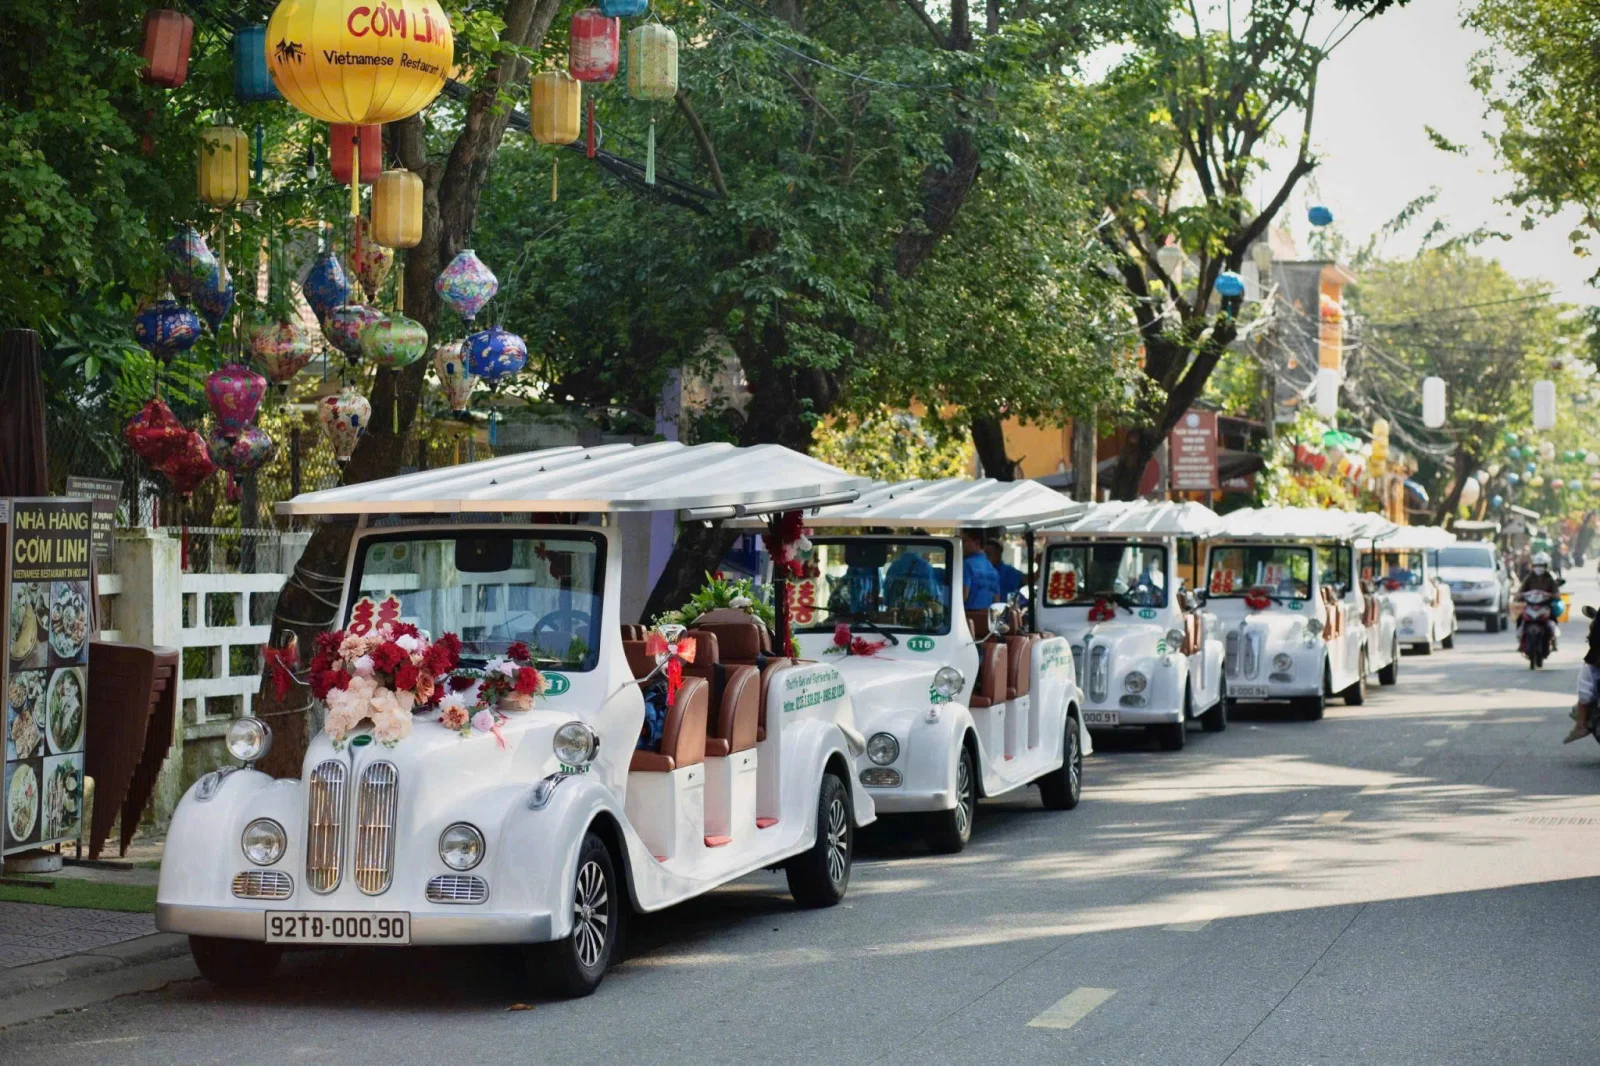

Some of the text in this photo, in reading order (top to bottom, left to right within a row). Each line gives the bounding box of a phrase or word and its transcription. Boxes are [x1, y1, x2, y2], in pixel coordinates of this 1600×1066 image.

[347, 1, 406, 39] CƠM
[323, 50, 394, 66] Vietnamese
[400, 53, 439, 76] Restaurant
[16, 508, 46, 530] NHÀ
[49, 508, 89, 530] HÀNG
[15, 535, 88, 563] CƠM LINH
[1083, 713, 1116, 723] 000.91
[271, 916, 404, 938] 92TĐ-000.90
